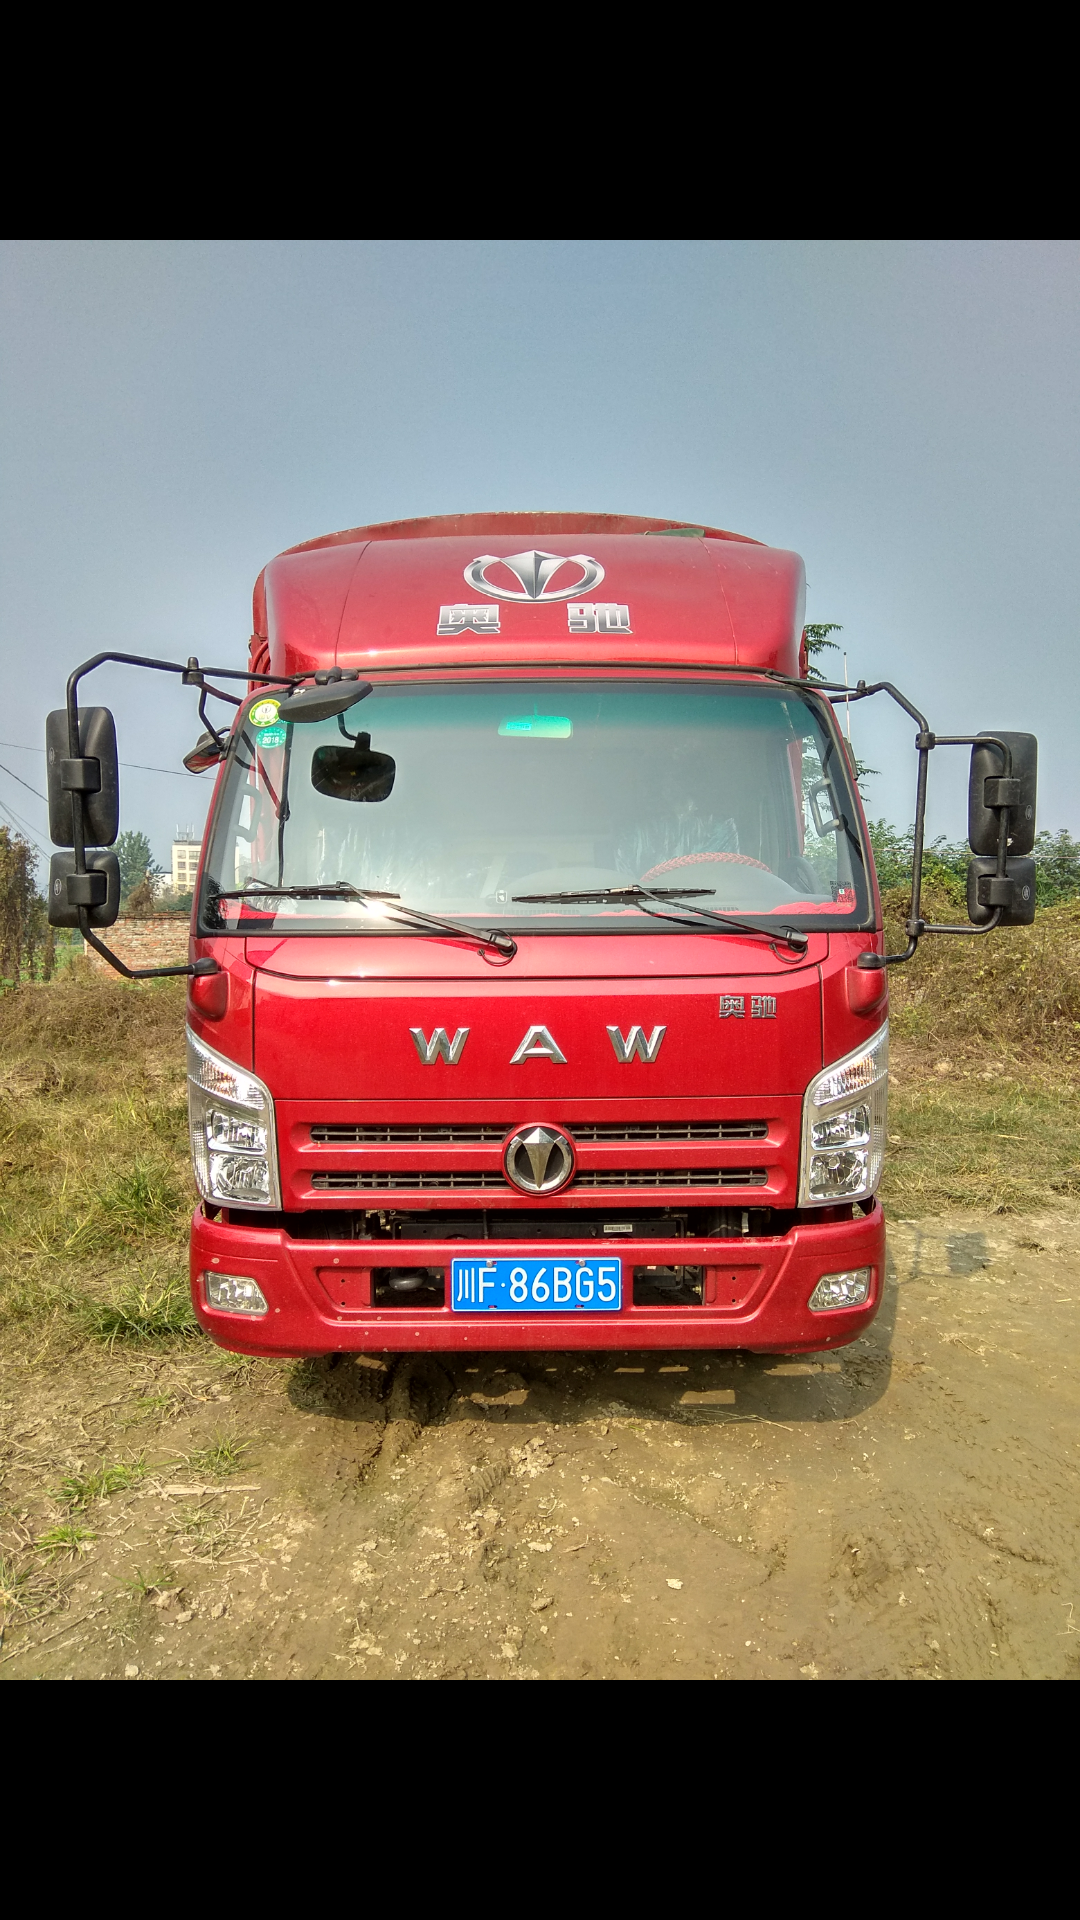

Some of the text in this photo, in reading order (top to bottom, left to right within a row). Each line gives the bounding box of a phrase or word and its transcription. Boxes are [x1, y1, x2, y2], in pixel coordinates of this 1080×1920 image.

[437, 603, 633, 635] 奥驰
[719, 995, 777, 1018] 奥驰
[409, 1025, 667, 1065] WAW
